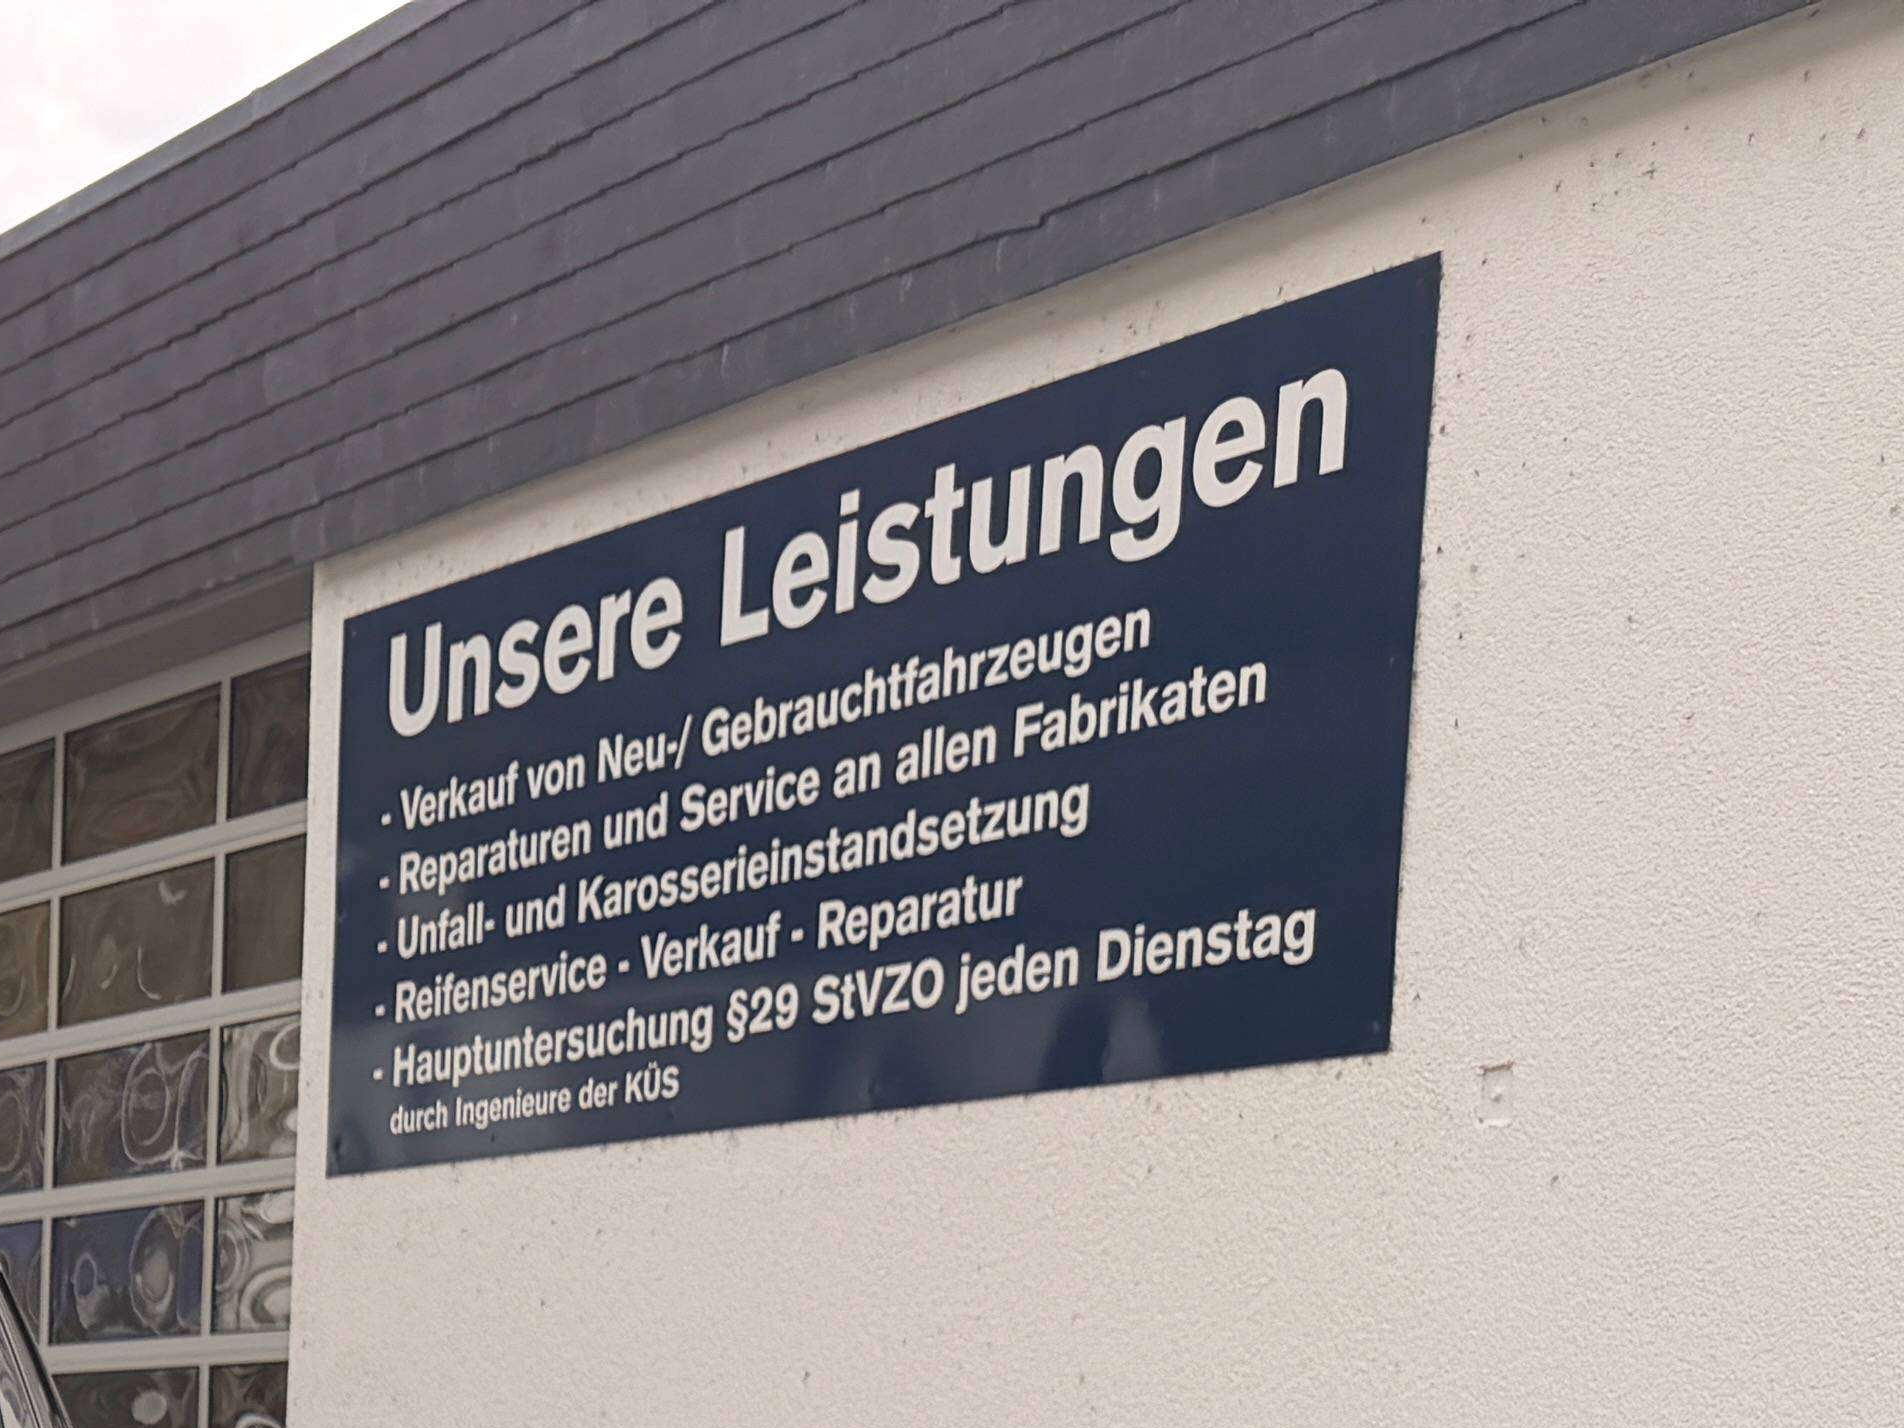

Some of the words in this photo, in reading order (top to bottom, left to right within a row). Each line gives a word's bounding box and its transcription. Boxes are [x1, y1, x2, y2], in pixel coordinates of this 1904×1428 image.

[389, 577, 682, 737] Unsere
[719, 366, 1348, 646] Leistungen
[399, 820, 591, 896] Reparaturen
[603, 791, 668, 849] und
[680, 766, 820, 832] Service
[833, 752, 881, 799] an
[895, 724, 997, 785] allen
[1013, 661, 1268, 758] Fabrikaten
[400, 761, 518, 830] Verkauf
[527, 753, 585, 799] von
[597, 714, 693, 783] Neu-/
[701, 607, 1151, 757] Gebrauchtfahrzeugen
[395, 950, 607, 1024] Reifenservice
[640, 911, 782, 979] Verkauf
[817, 875, 1024, 951] Reparatur
[397, 902, 495, 959] Unfall-
[505, 884, 566, 938] und
[577, 782, 1091, 923] Karosserieinstandsetzung
[393, 1004, 713, 1088] Hauptuntersuchung
[725, 981, 799, 1044] §29
[812, 957, 945, 1025] StVZO
[955, 944, 1079, 1015] jeden
[1096, 906, 1318, 982] Dienstag
[390, 1099, 448, 1135] durch
[455, 1086, 571, 1130] Ingenieure
[579, 1078, 618, 1110] der
[624, 1062, 680, 1103] KÜS
